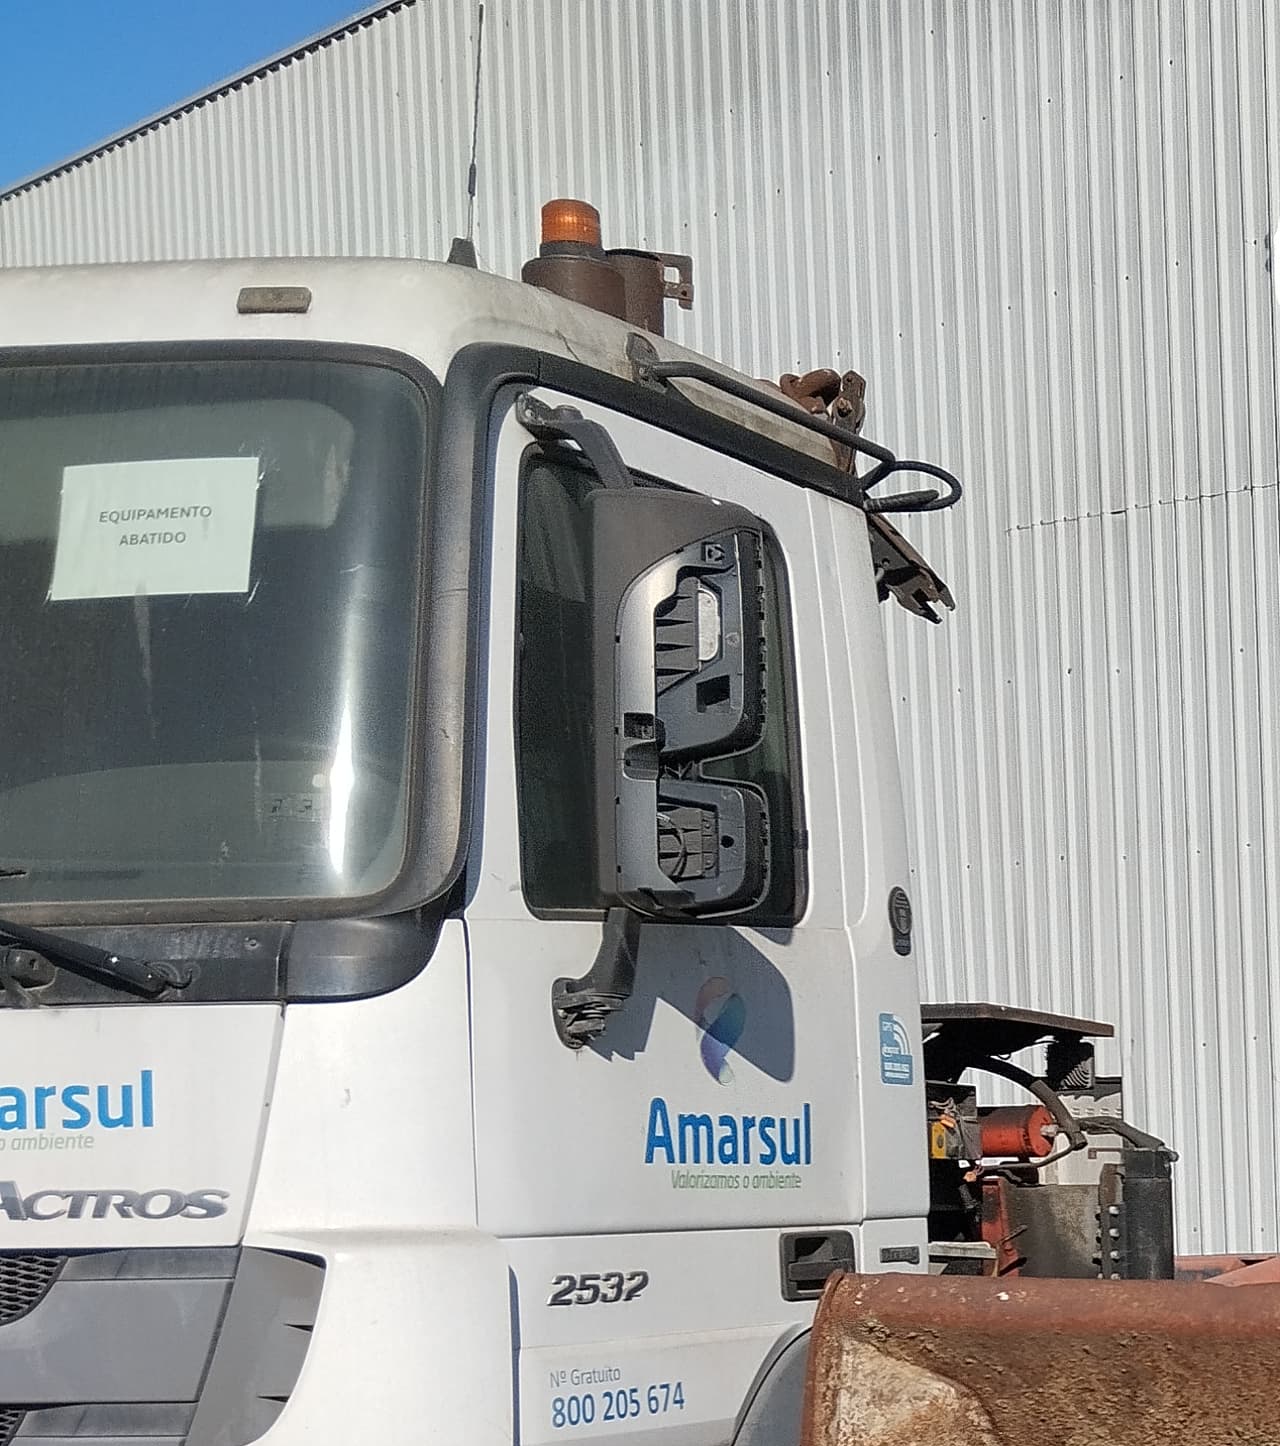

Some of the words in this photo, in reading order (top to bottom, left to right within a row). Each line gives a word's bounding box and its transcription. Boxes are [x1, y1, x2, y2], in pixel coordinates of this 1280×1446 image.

[98, 505, 213, 525] EQUIPAMENTO
[119, 531, 187, 547] ABATIDO
[0, 1069, 154, 1131] arsul
[11, 1132, 95, 1151] ambiente
[645, 1097, 812, 1166] Amarsul
[671, 1170, 740, 1190] Valorizamos
[743, 1174, 750, 1189] o
[752, 1171, 803, 1189] ambiente
[546, 1270, 650, 1307] 2532
[570, 1366, 621, 1386] Gratuito
[551, 1393, 596, 1428] 800
[601, 1387, 641, 1422] 205
[647, 1381, 685, 1415] 674
